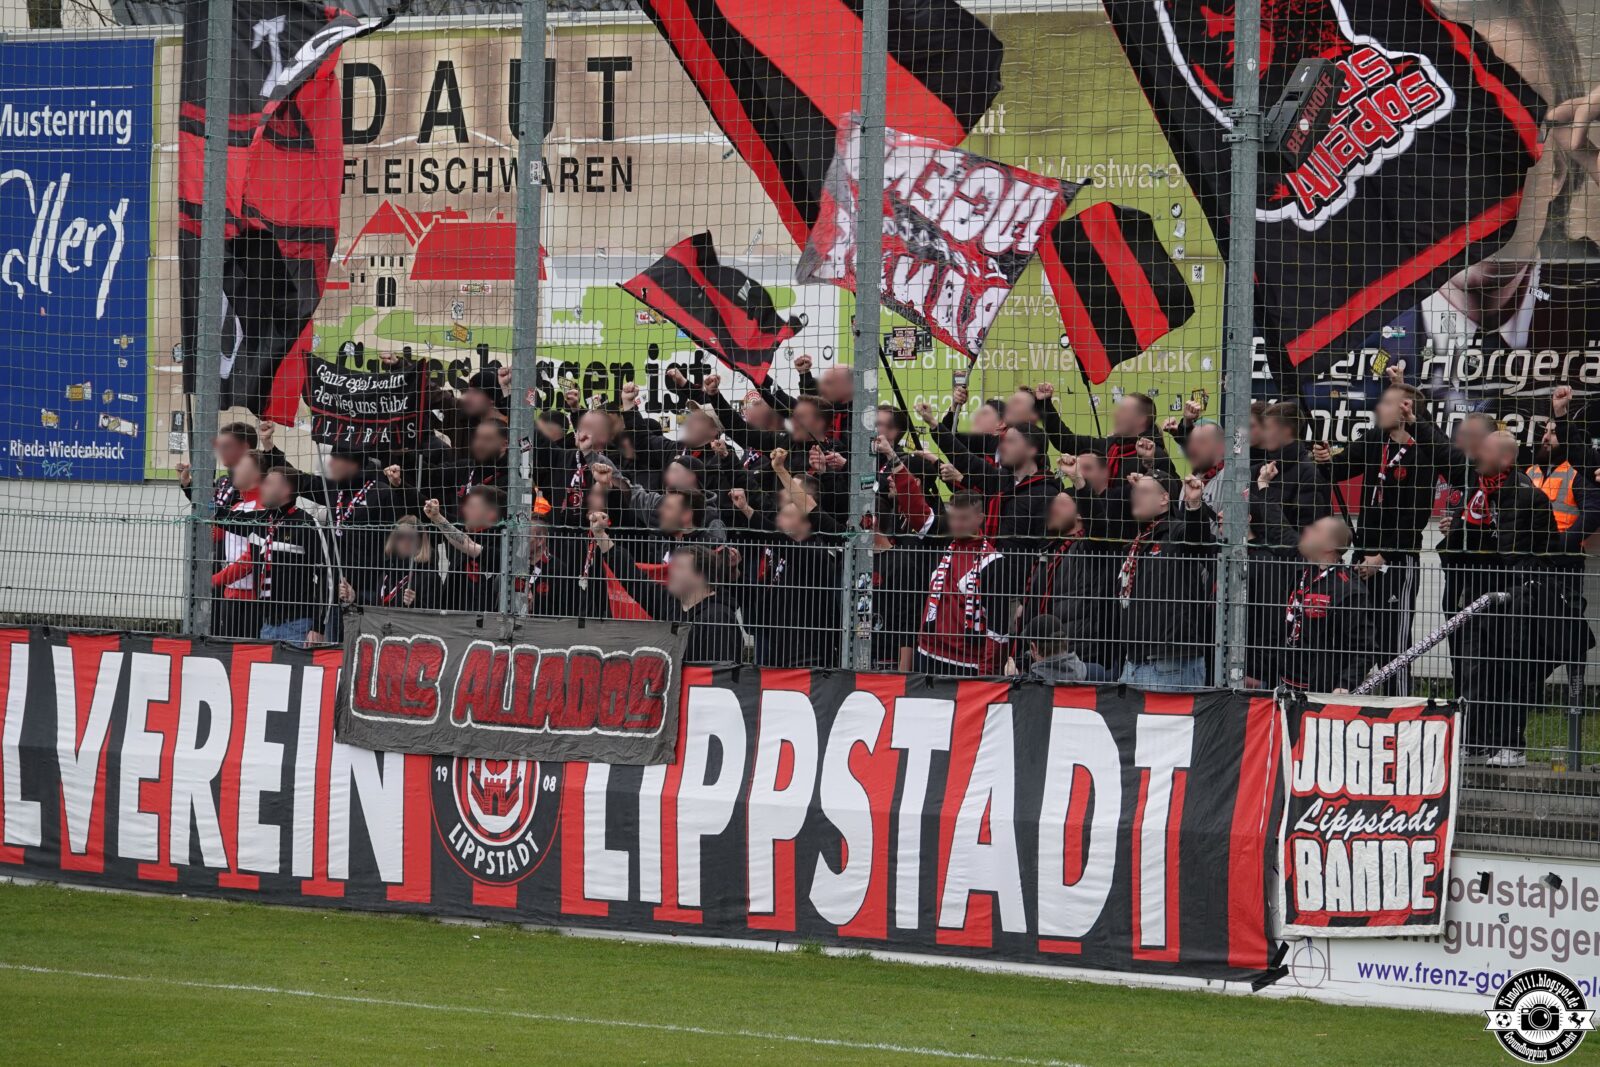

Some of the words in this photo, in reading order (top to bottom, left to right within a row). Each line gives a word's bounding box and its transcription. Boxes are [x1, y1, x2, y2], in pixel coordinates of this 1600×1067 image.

[341, 56, 633, 145] DAUT
[341, 155, 633, 194] FLEISCHWAREN
[355, 399, 378, 414] uns
[352, 634, 448, 725] LOS
[435, 764, 449, 783] 19
[542, 774, 557, 793] 08
[1292, 716, 1449, 796] JUGEND
[448, 822, 541, 877] LIPPSTADT
[582, 686, 1195, 949] LIPPSTADT
[1293, 797, 1439, 841] Lippstadt
[1294, 838, 1437, 913] BANDE
